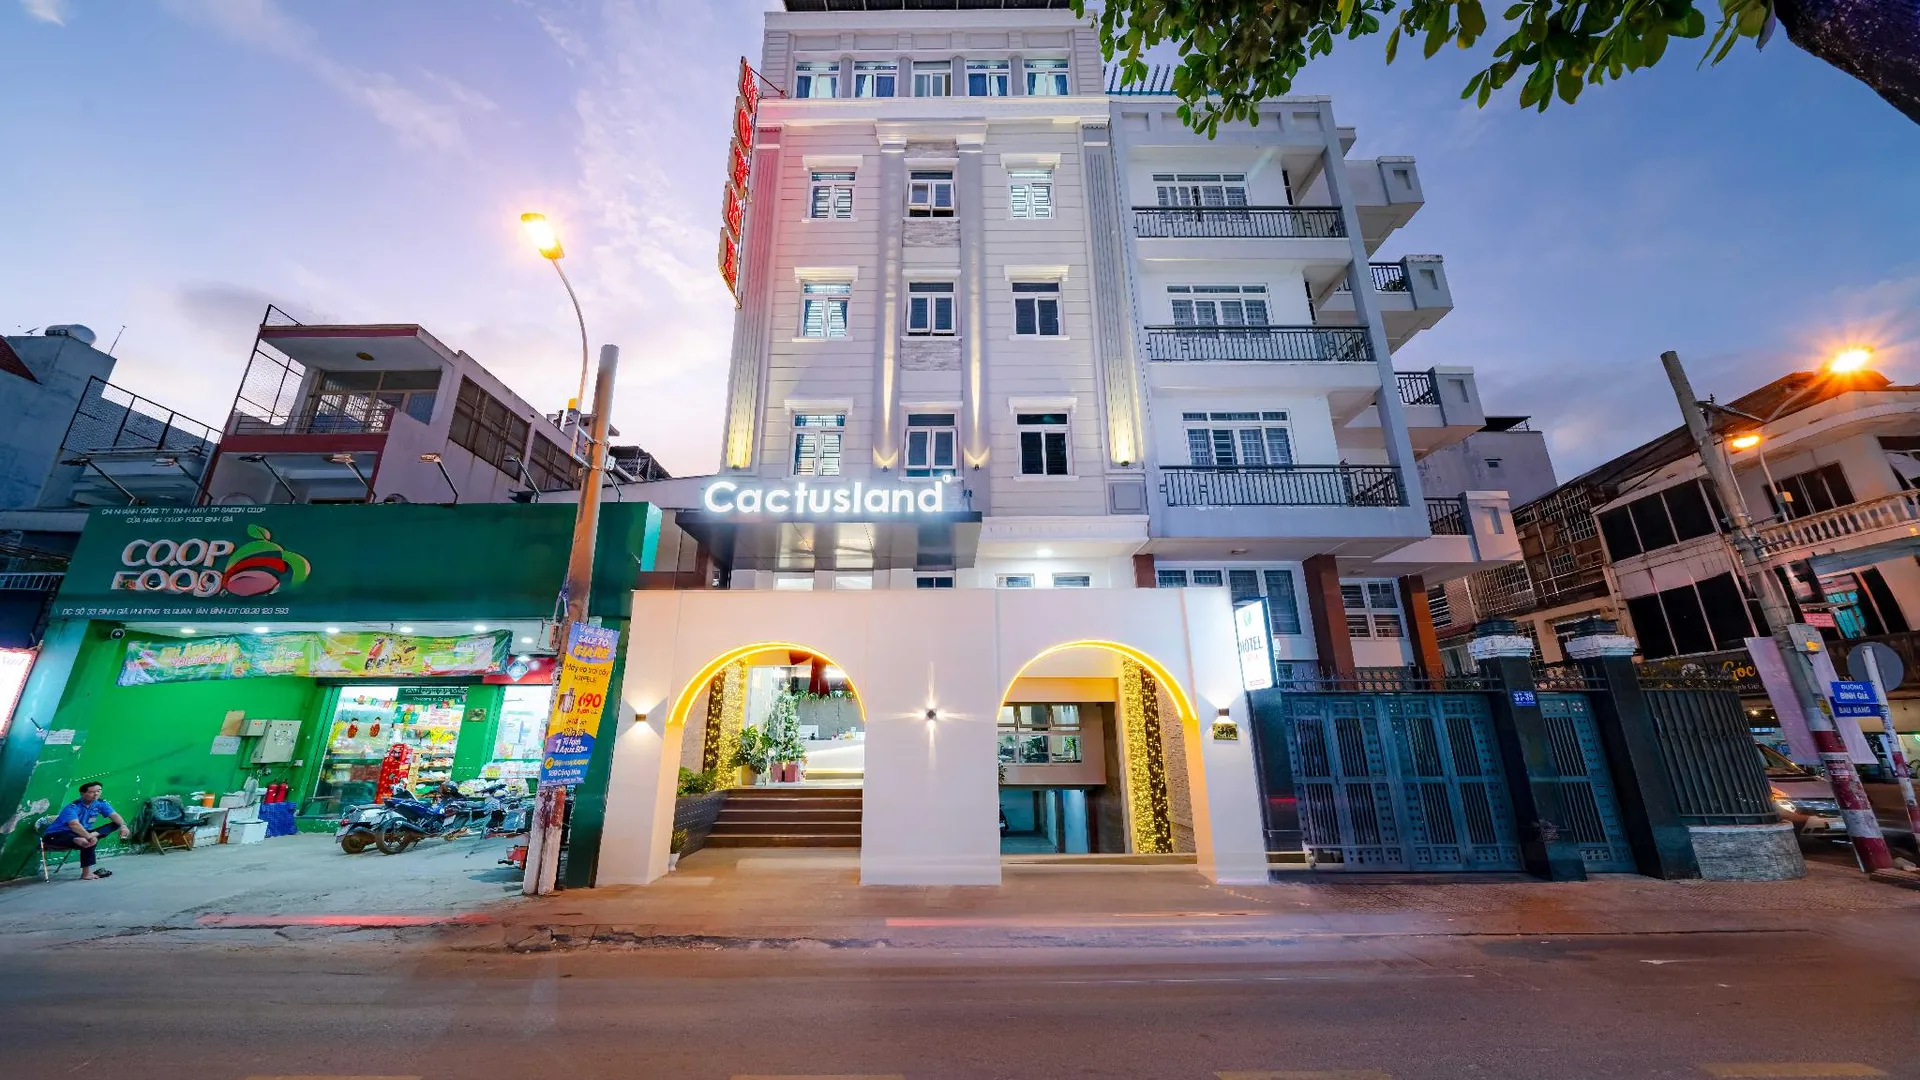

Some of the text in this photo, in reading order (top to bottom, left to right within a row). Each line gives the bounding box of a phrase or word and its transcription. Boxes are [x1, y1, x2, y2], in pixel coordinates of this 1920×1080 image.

[704, 481, 942, 513] Cactusland
[110, 568, 224, 598] FOOD
[1240, 635, 1264, 653] HOTEL
